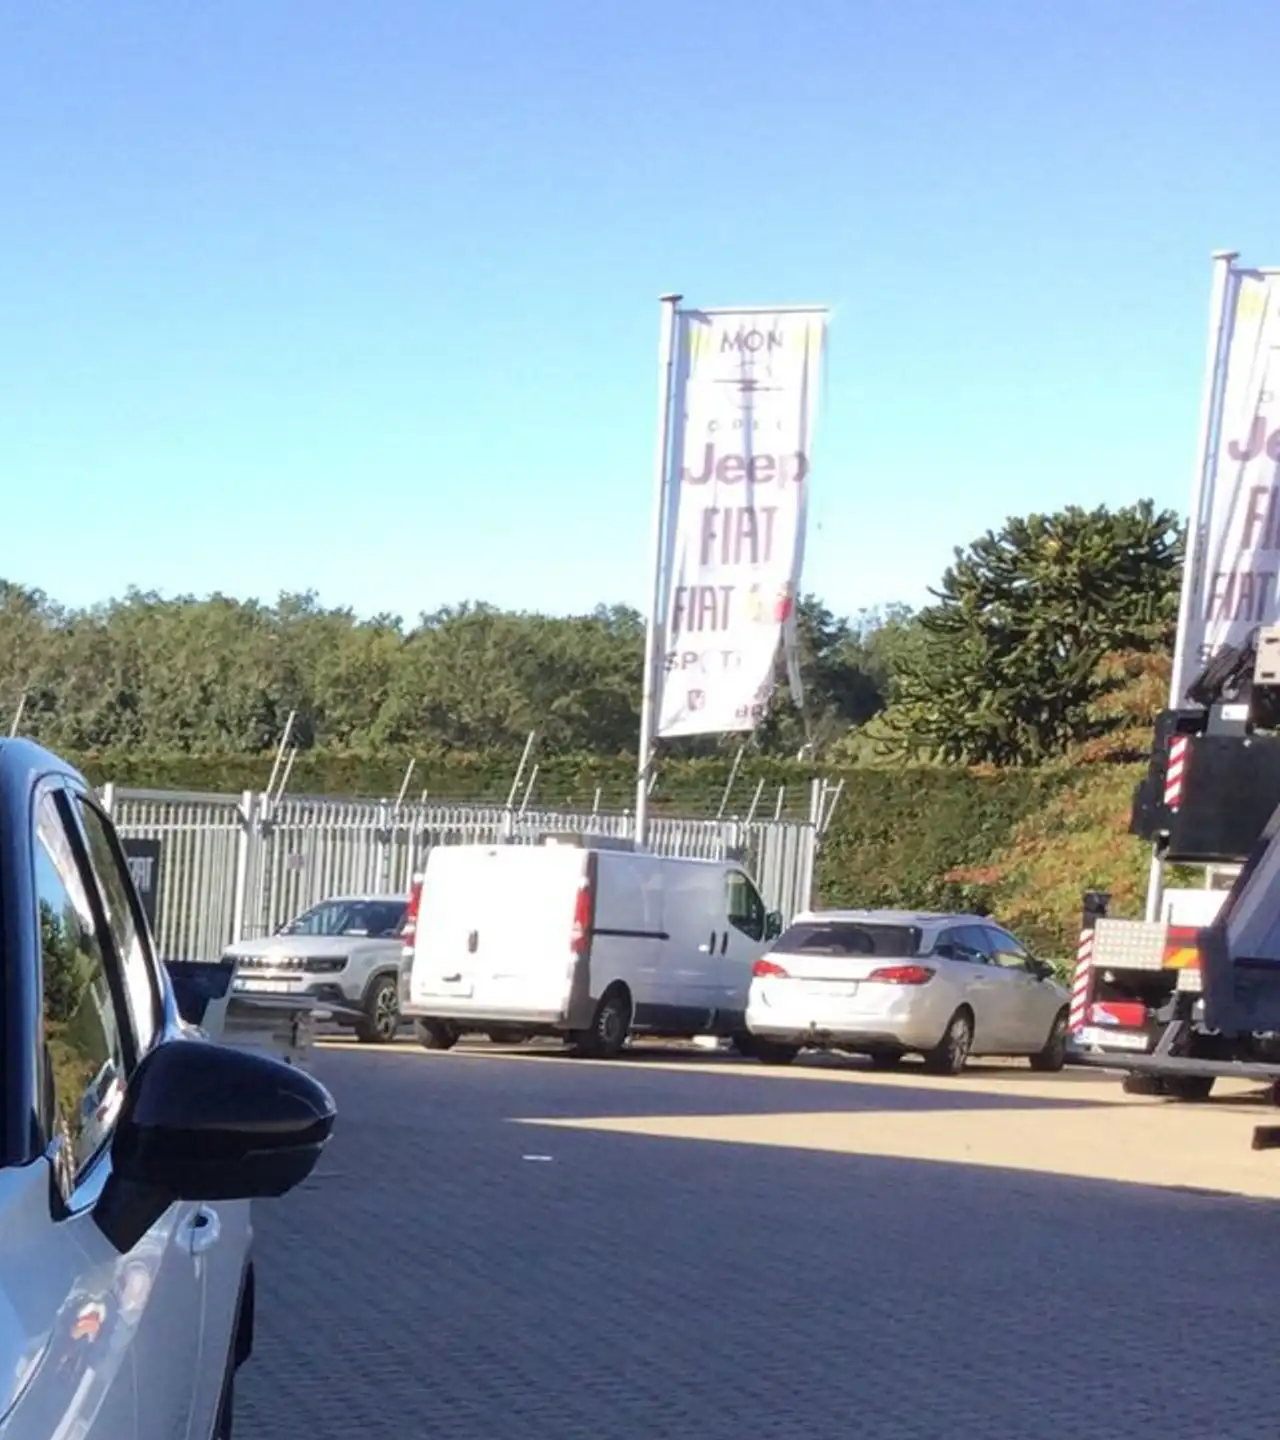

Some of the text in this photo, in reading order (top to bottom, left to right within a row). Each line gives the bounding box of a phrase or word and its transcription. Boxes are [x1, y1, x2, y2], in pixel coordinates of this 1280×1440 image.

[720, 329, 784, 353] MON
[681, 441, 809, 489] Jeep
[700, 506, 779, 566] FIAT
[671, 585, 736, 634] FIAT
